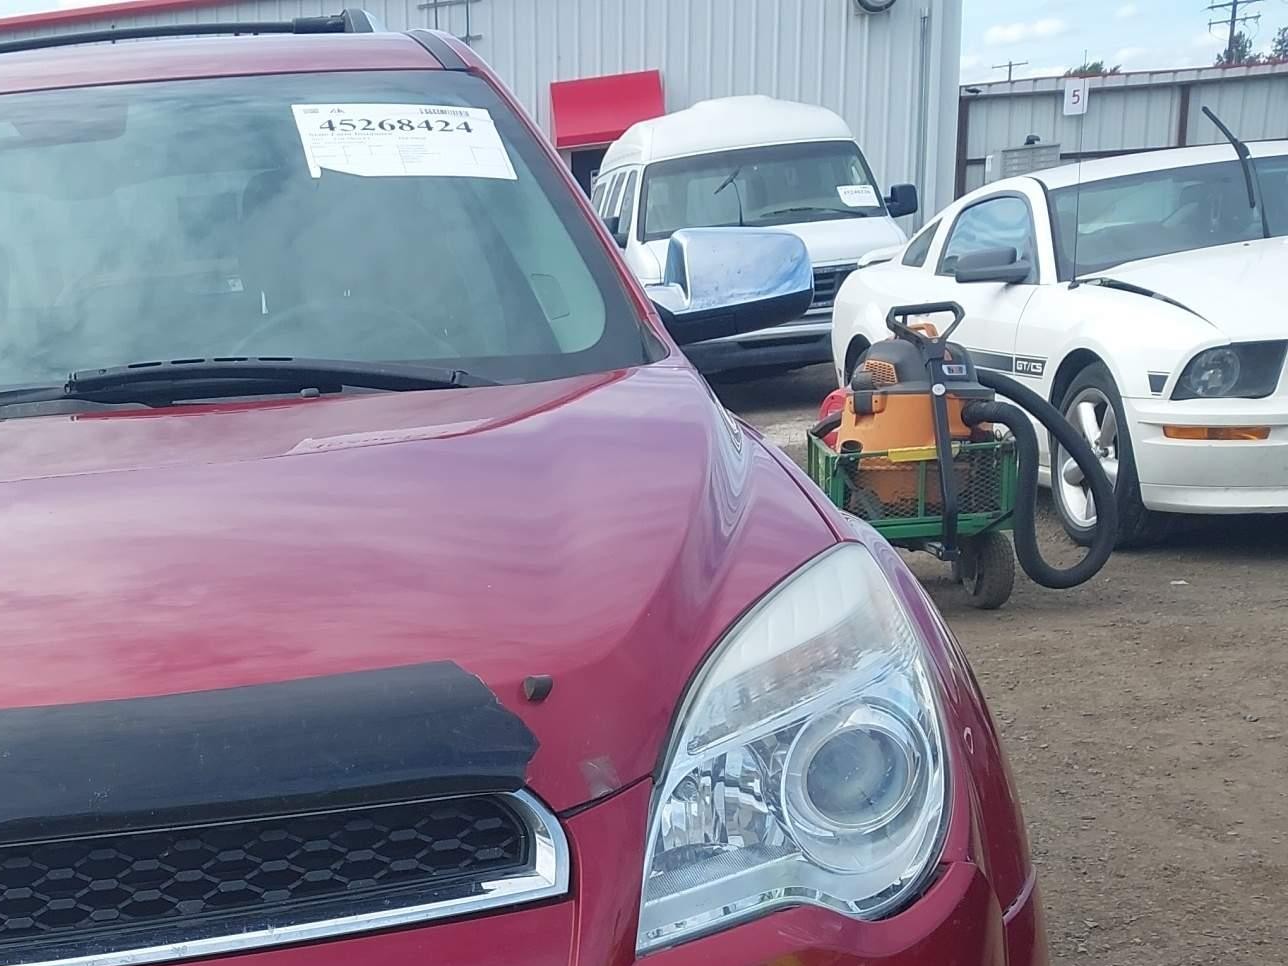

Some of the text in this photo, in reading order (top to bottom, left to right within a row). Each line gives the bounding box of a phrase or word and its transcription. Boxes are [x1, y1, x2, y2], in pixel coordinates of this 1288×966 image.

[1072, 89, 1080, 104] 5
[319, 118, 473, 133] 45268424
[1016, 360, 1043, 373] GT/CS
